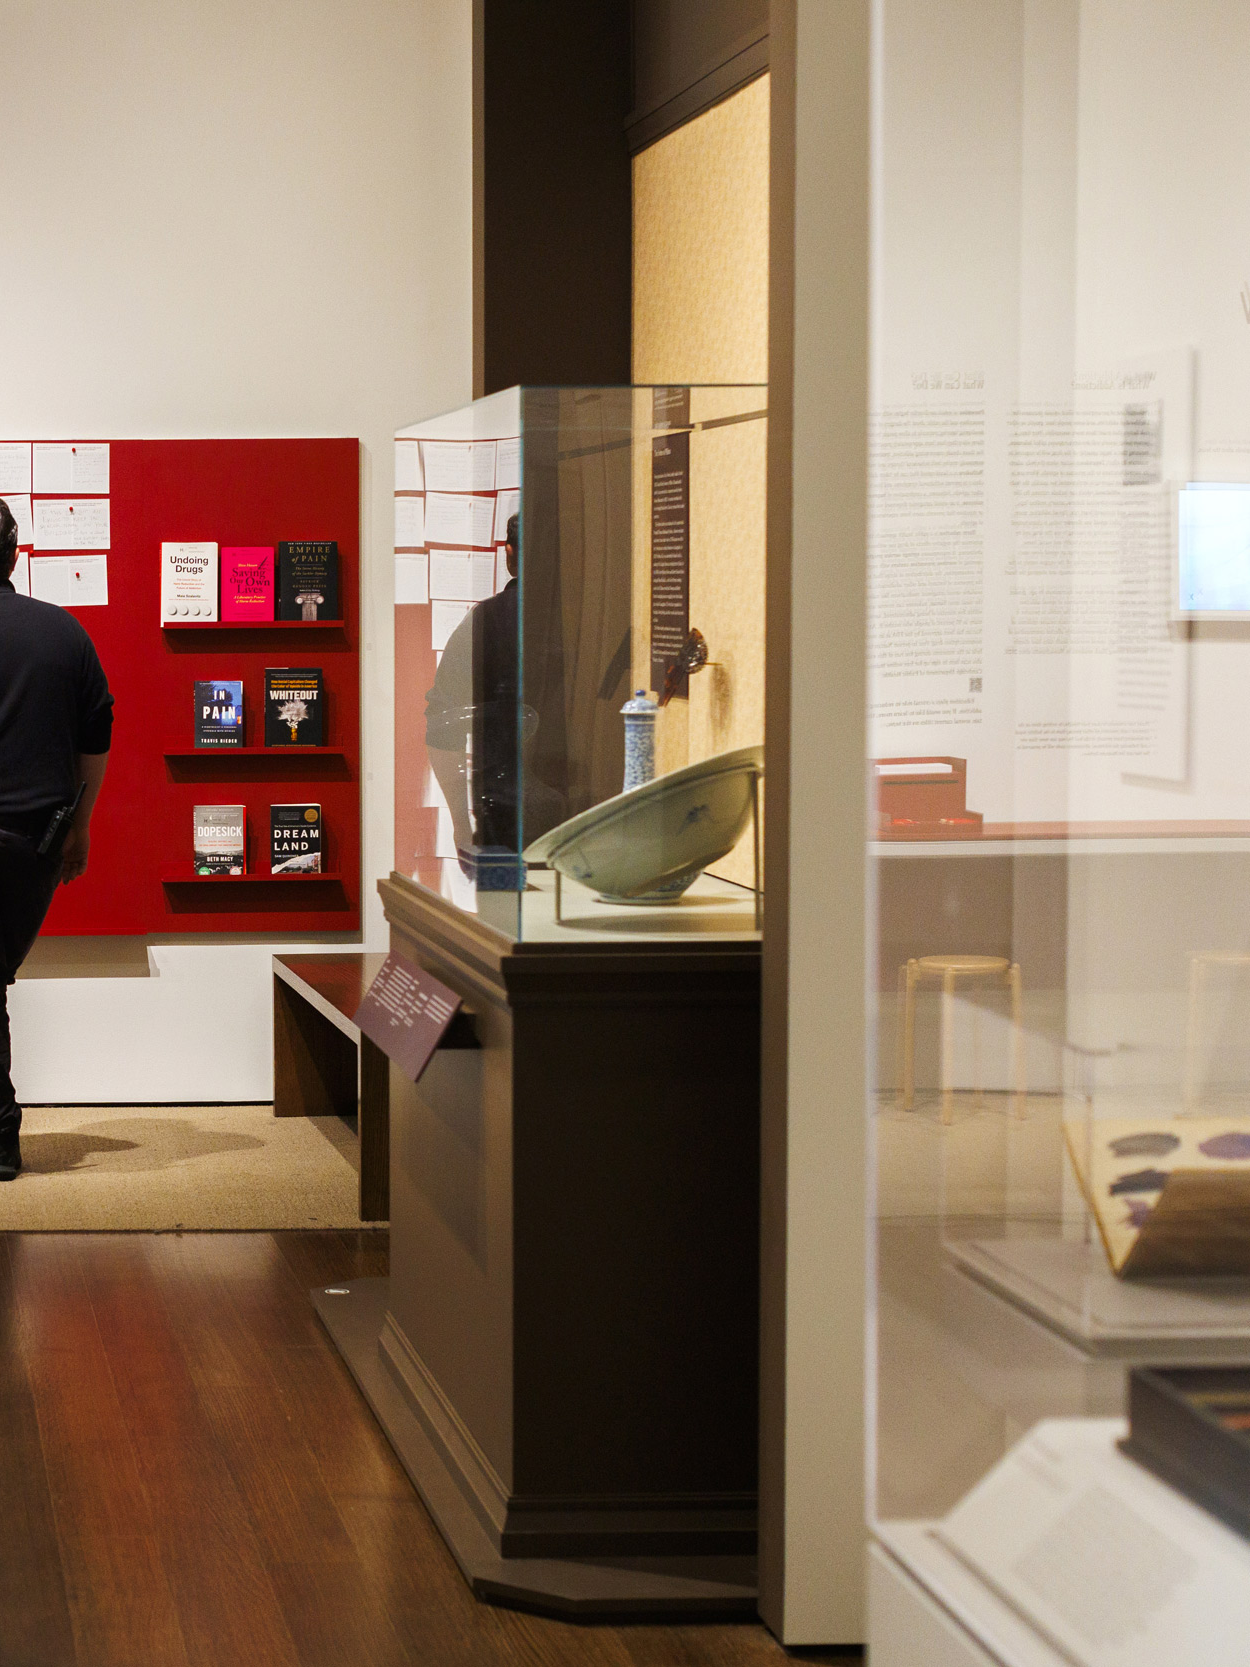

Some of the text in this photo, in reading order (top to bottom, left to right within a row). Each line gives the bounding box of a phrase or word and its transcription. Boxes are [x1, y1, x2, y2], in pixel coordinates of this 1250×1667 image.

[289, 546, 331, 554] EMPIRE
[170, 556, 209, 566] Undoing
[291, 556, 299, 564] of
[175, 565, 204, 574] Drugs
[232, 568, 266, 580] Saving
[245, 577, 270, 586] Own
[237, 584, 263, 594] Lives
[213, 690, 225, 700] IN
[269, 690, 319, 700] WHITEOUT
[202, 706, 236, 719] PAIN
[197, 826, 242, 837] DOPESICK
[274, 829, 319, 838] DREAM
[274, 842, 309, 851] LAND
